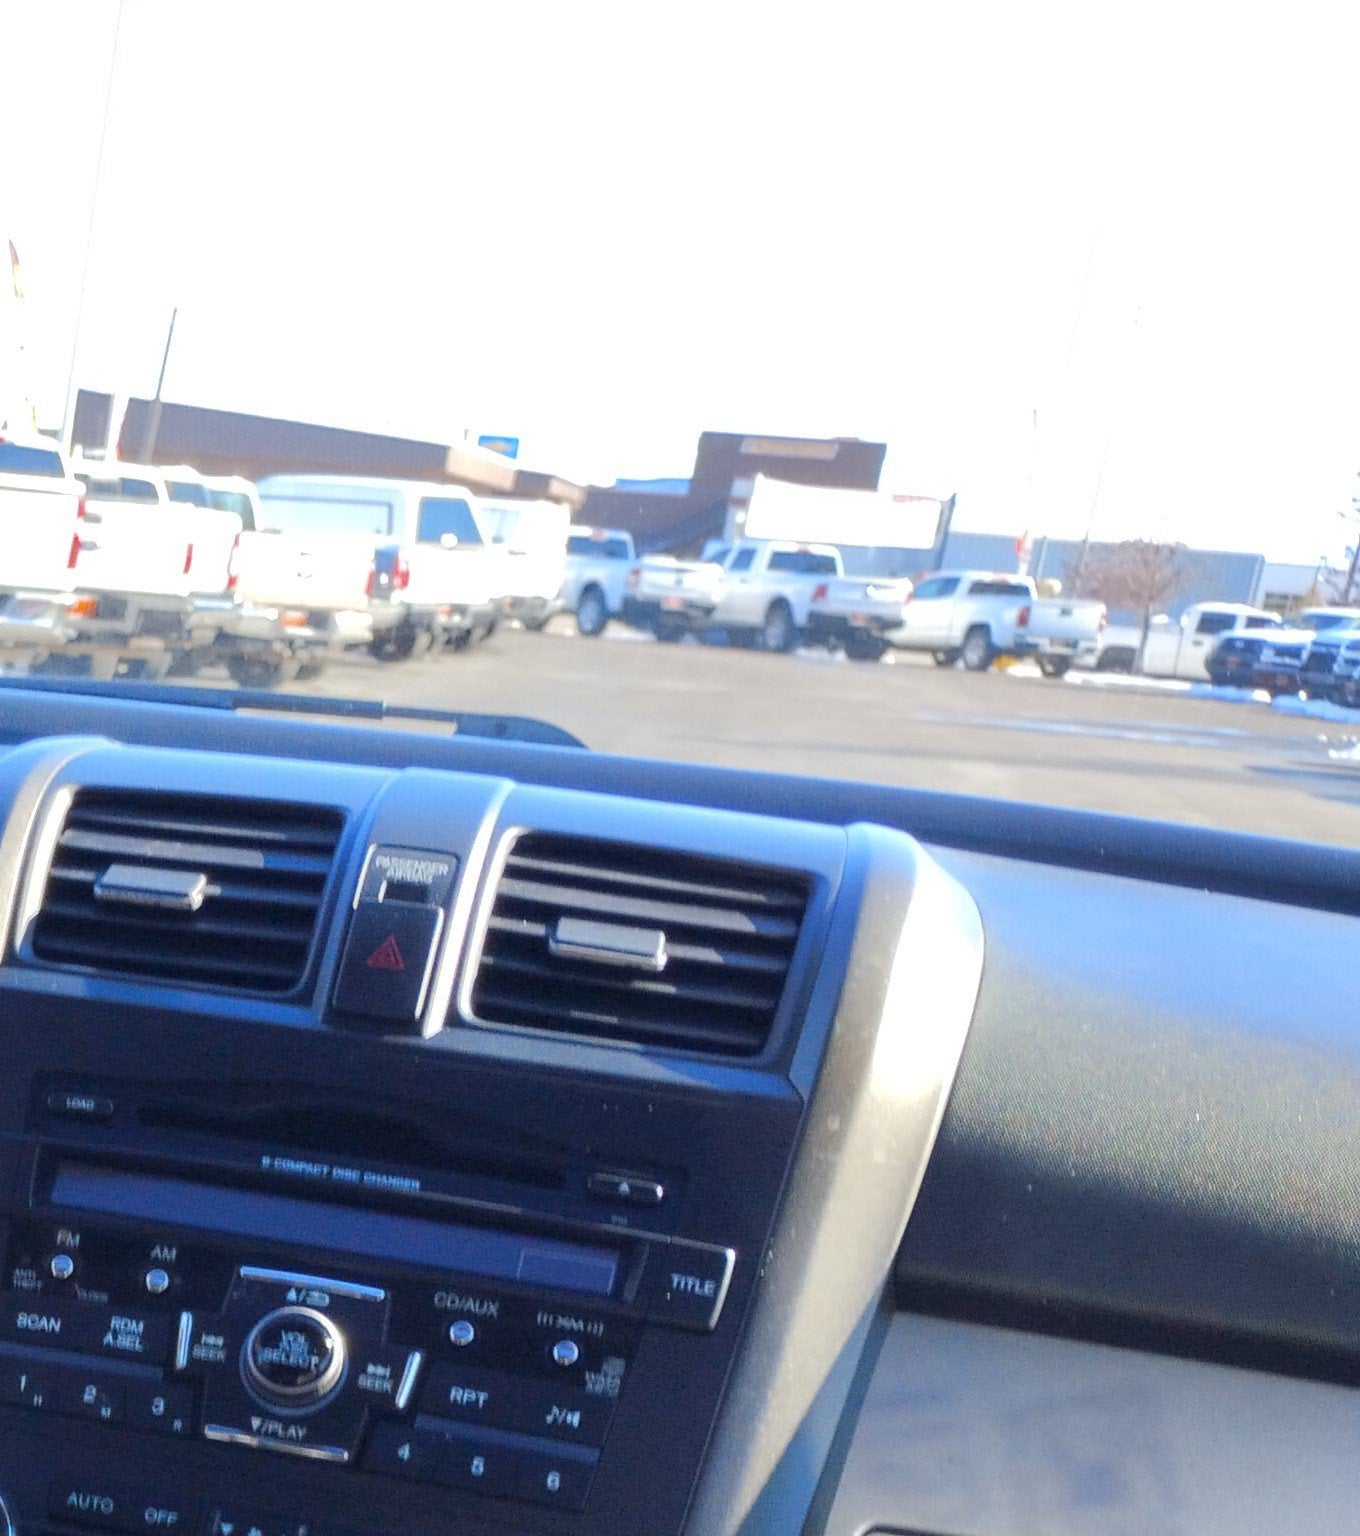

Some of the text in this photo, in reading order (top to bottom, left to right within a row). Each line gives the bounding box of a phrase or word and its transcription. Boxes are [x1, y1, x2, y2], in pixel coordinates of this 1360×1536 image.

[56, 1228, 81, 1248] FM
[149, 1243, 177, 1264] AM
[670, 1272, 716, 1298] TITLE
[433, 1291, 499, 1319] CD/AUX
[16, 1312, 62, 1335] SCAN
[449, 1385, 489, 1410] RPT
[67, 1490, 115, 1516] AUTO
[143, 1505, 179, 1528] OFF
